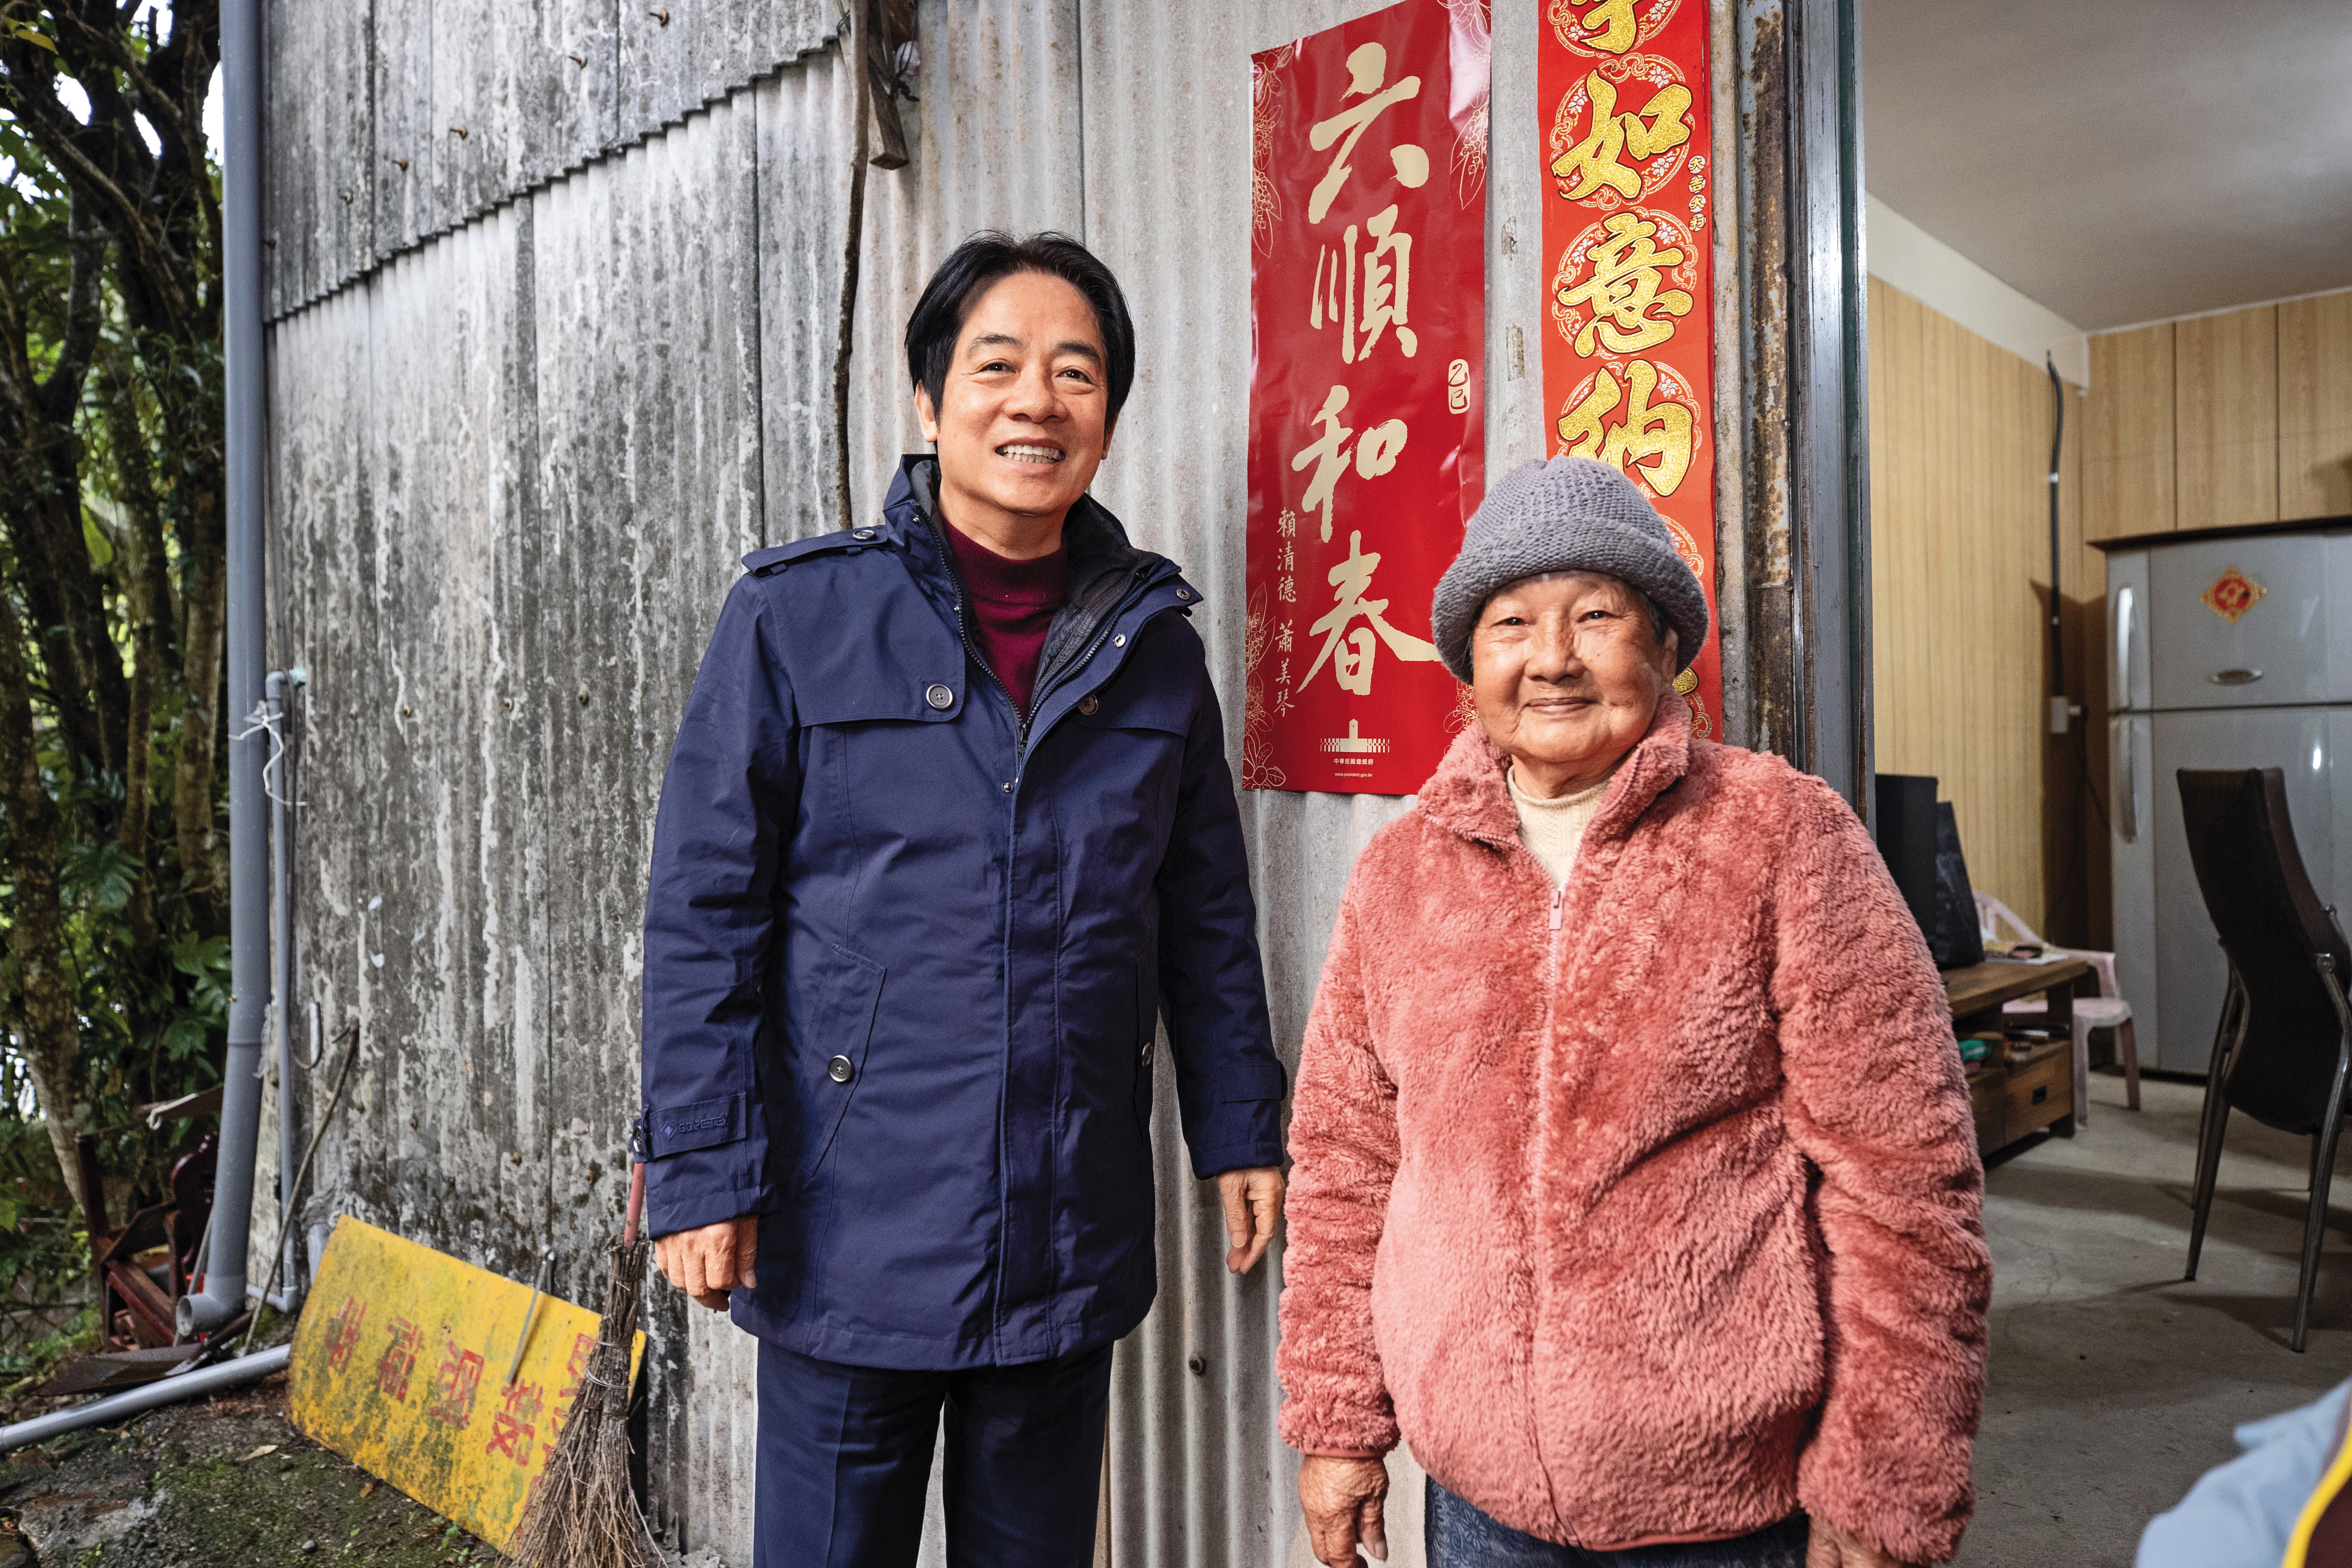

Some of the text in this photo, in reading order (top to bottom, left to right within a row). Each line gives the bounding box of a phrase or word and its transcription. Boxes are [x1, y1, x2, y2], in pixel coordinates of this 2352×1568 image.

[1292, 41, 1442, 696] 六順和春
[1551, 0, 1699, 721] 如意納
[1688, 156, 1706, 231] 大吉大利
[1274, 507, 1296, 717] 賴清德 蕭美琴
